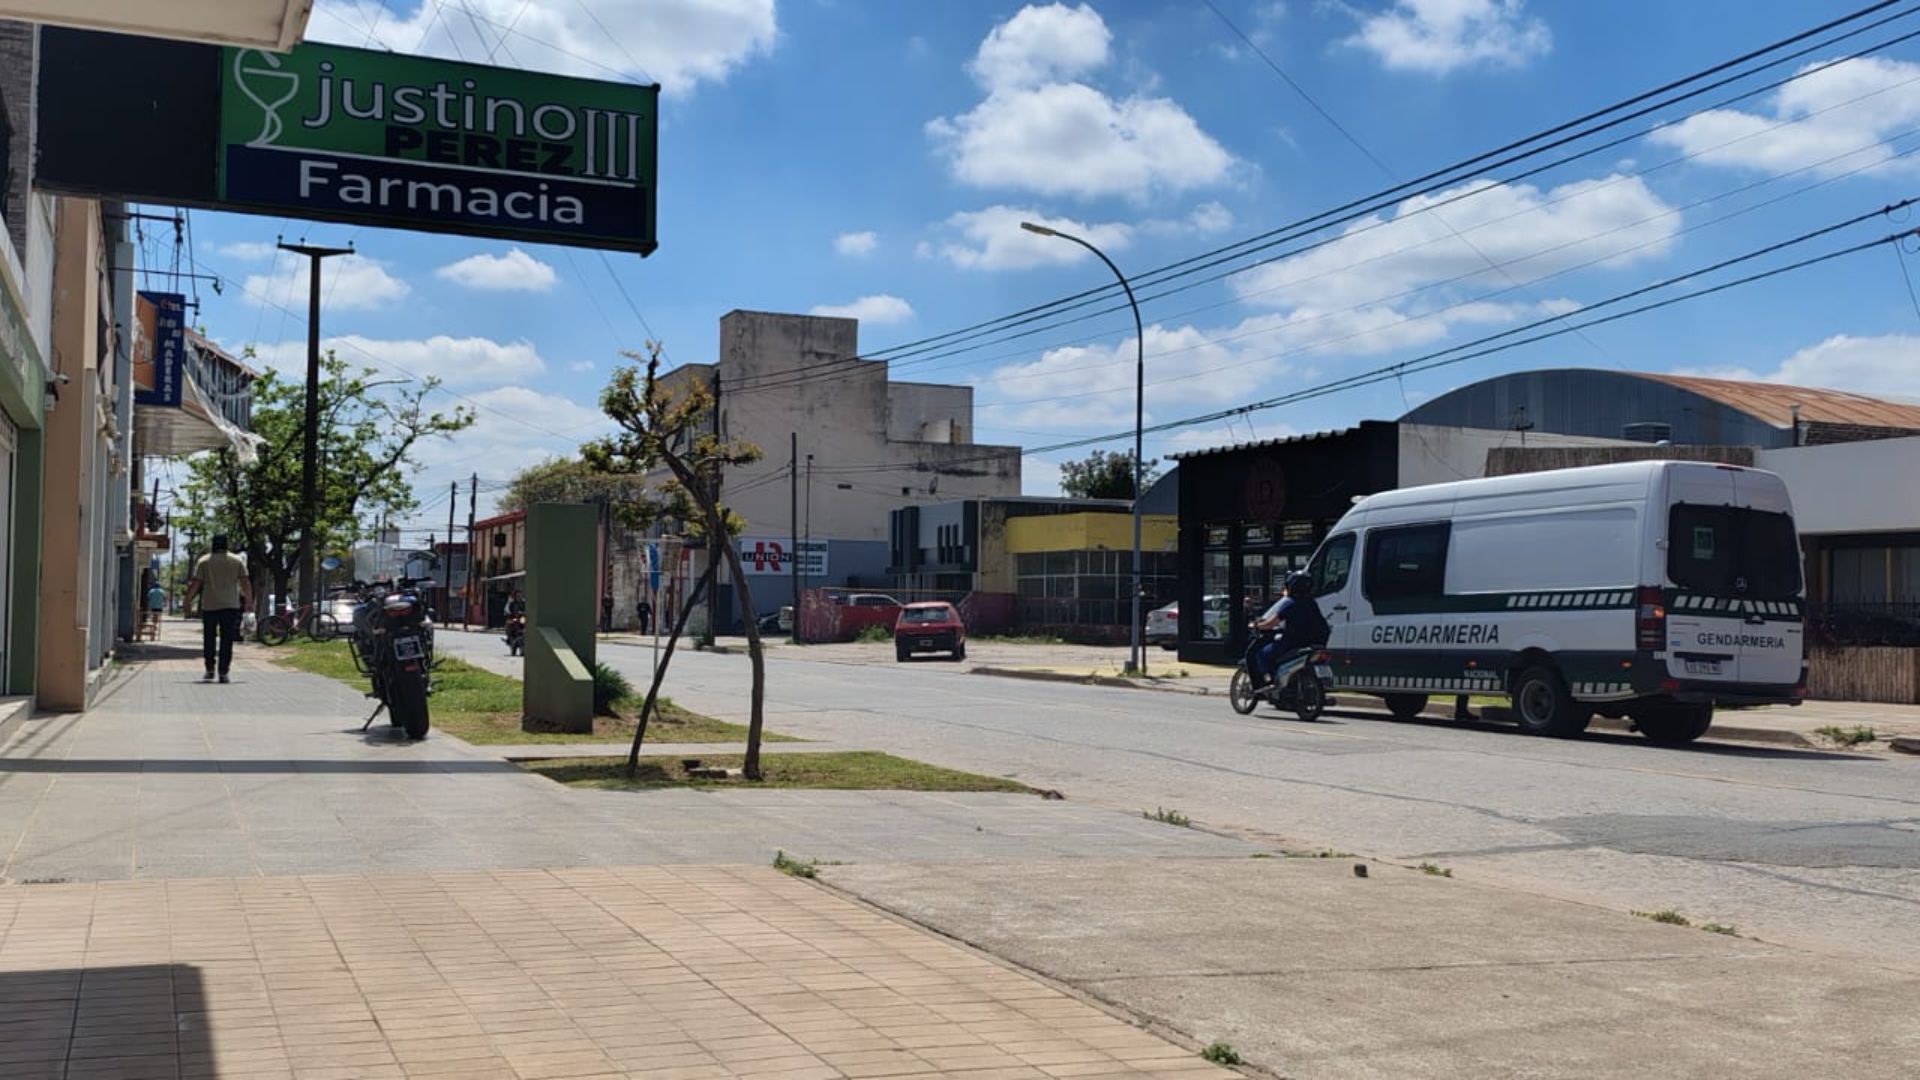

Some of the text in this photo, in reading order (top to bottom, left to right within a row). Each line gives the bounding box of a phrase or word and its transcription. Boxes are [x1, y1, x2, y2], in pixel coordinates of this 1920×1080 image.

[302, 61, 644, 181] justino III
[384, 125, 575, 177] PEREZ
[300, 159, 585, 226] Farmacia
[163, 340, 176, 402] MADERAS
[742, 552, 793, 563] UNION
[1371, 624, 1500, 644] GENDARMERIA
[1697, 632, 1785, 649] GENDARMERIA
